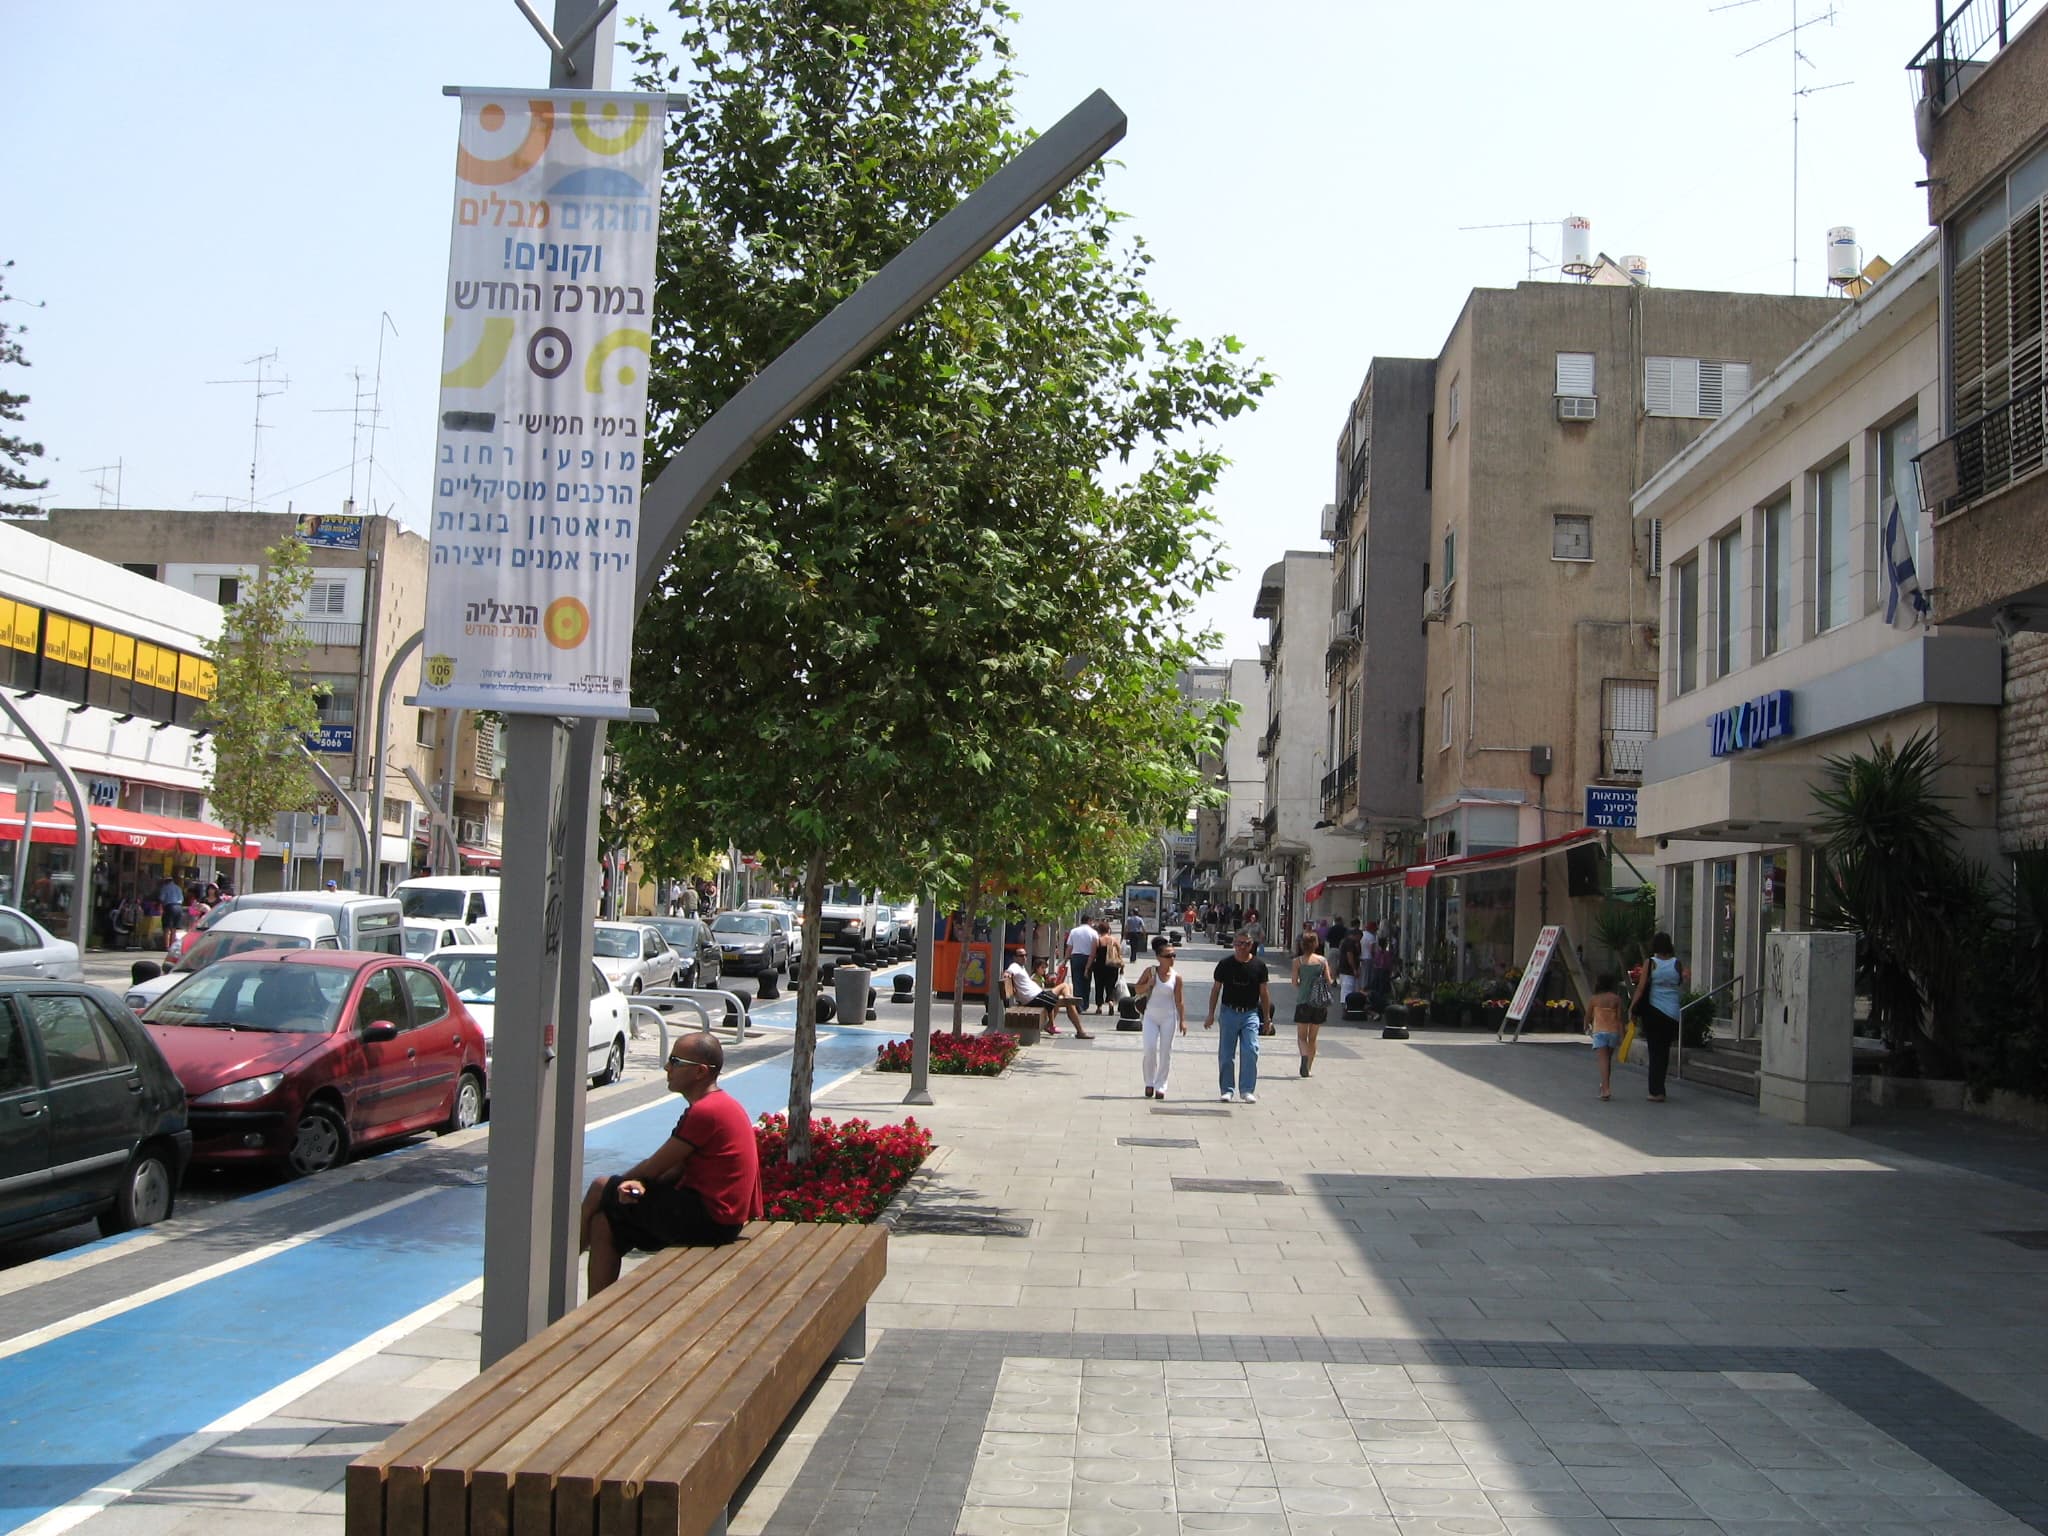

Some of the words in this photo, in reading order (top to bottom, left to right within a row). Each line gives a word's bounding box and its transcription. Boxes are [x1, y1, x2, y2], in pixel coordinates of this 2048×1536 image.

[458, 190, 550, 230] מבלים
[560, 201, 650, 233] חוגגים
[503, 237, 602, 281] וקונים!
[454, 280, 542, 312] החדש
[553, 283, 645, 315] במרכז
[517, 412, 584, 437] חמישי
[593, 416, 638, 438] בימי
[440, 444, 514, 466] רחוב
[541, 448, 636, 471] מופעי
[439, 473, 546, 503] מוסיקליים
[556, 484, 634, 505] הרכבים
[436, 511, 510, 533] בובות
[528, 515, 632, 540] תיאטרון
[433, 543, 502, 568] ויצירה
[511, 547, 580, 570] אמנים
[590, 551, 630, 573] יריד
[465, 598, 539, 625] הרצליה
[463, 622, 499, 639] החדש
[501, 624, 538, 640] המרכז
[431, 665, 451, 677] 106
[1592, 791, 1638, 802] שכנתאות
